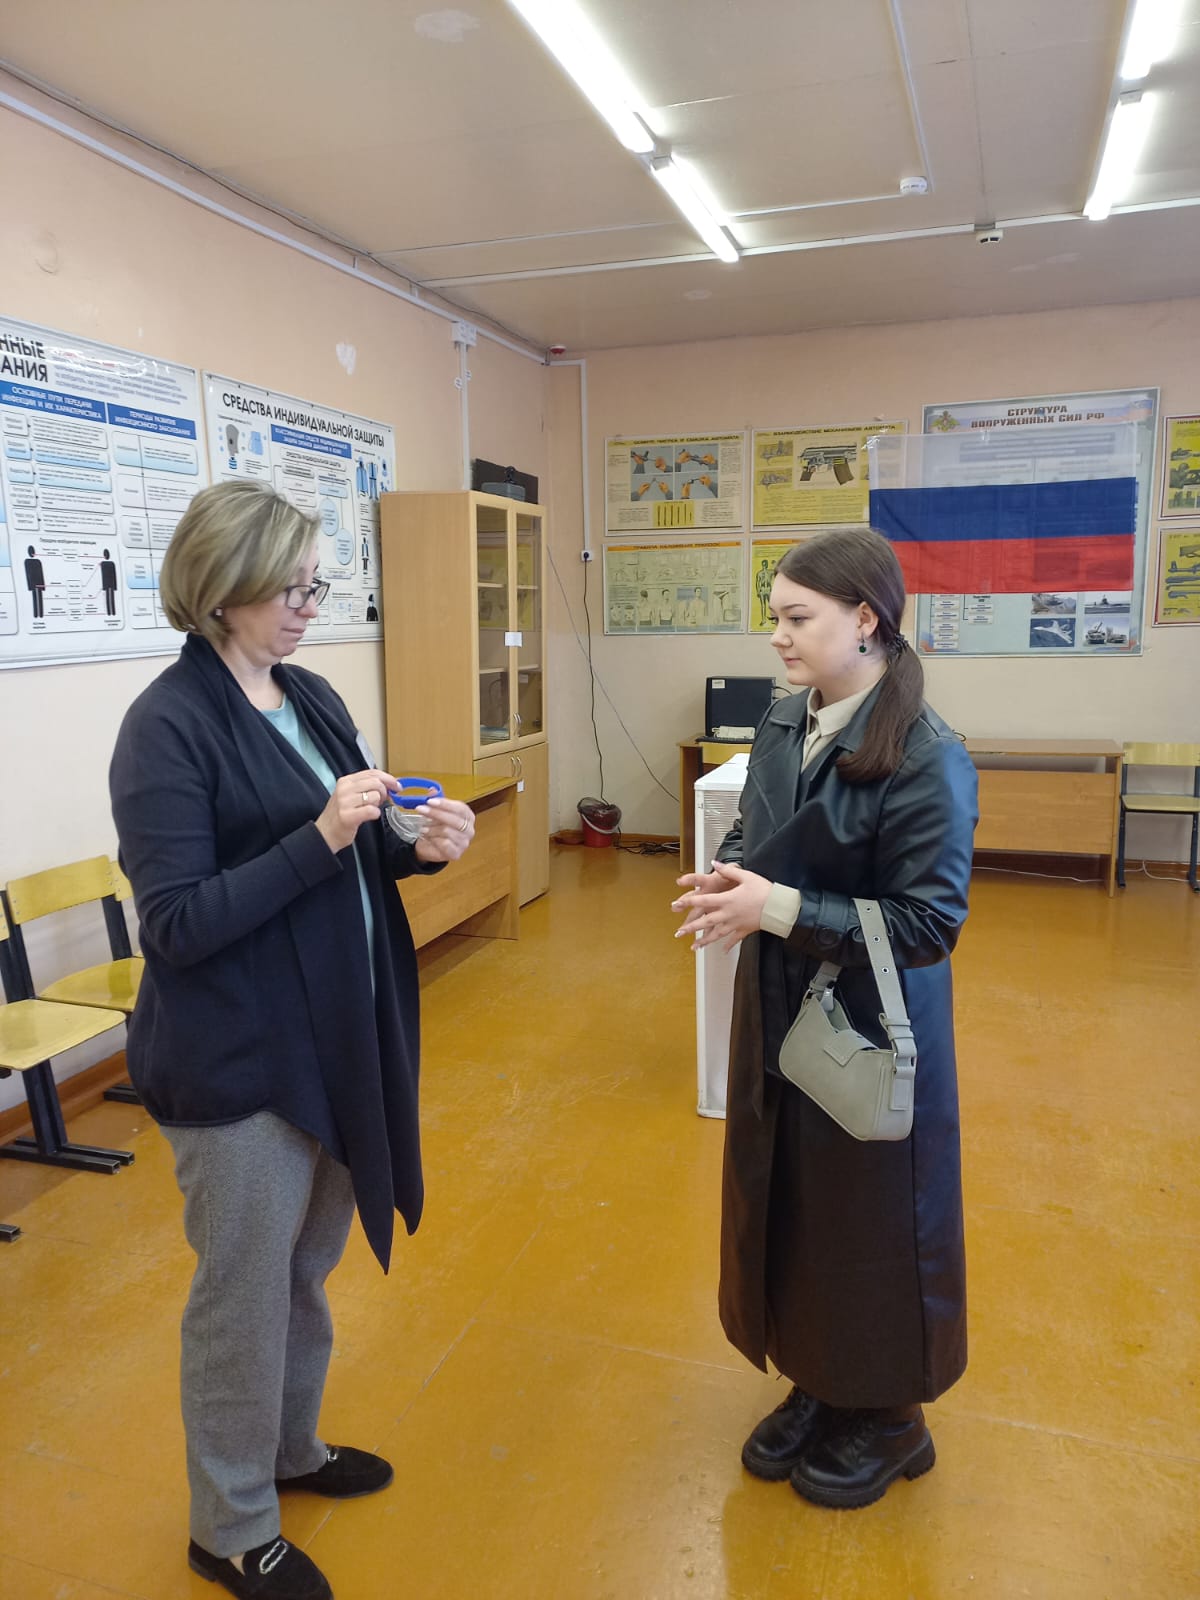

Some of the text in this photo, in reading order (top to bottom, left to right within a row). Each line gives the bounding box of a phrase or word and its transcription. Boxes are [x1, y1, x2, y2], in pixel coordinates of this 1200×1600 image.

[1, 355, 48, 383] АНИЯ
[222, 392, 273, 418] СРЕДСТВА
[273, 406, 354, 440] ИНДИВИДУАЛЬНОЙ
[354, 428, 385, 448] ЗАЩИТЫ
[971, 412, 1105, 429] ВООРУЖЕННЫХ СИЛ РФ
